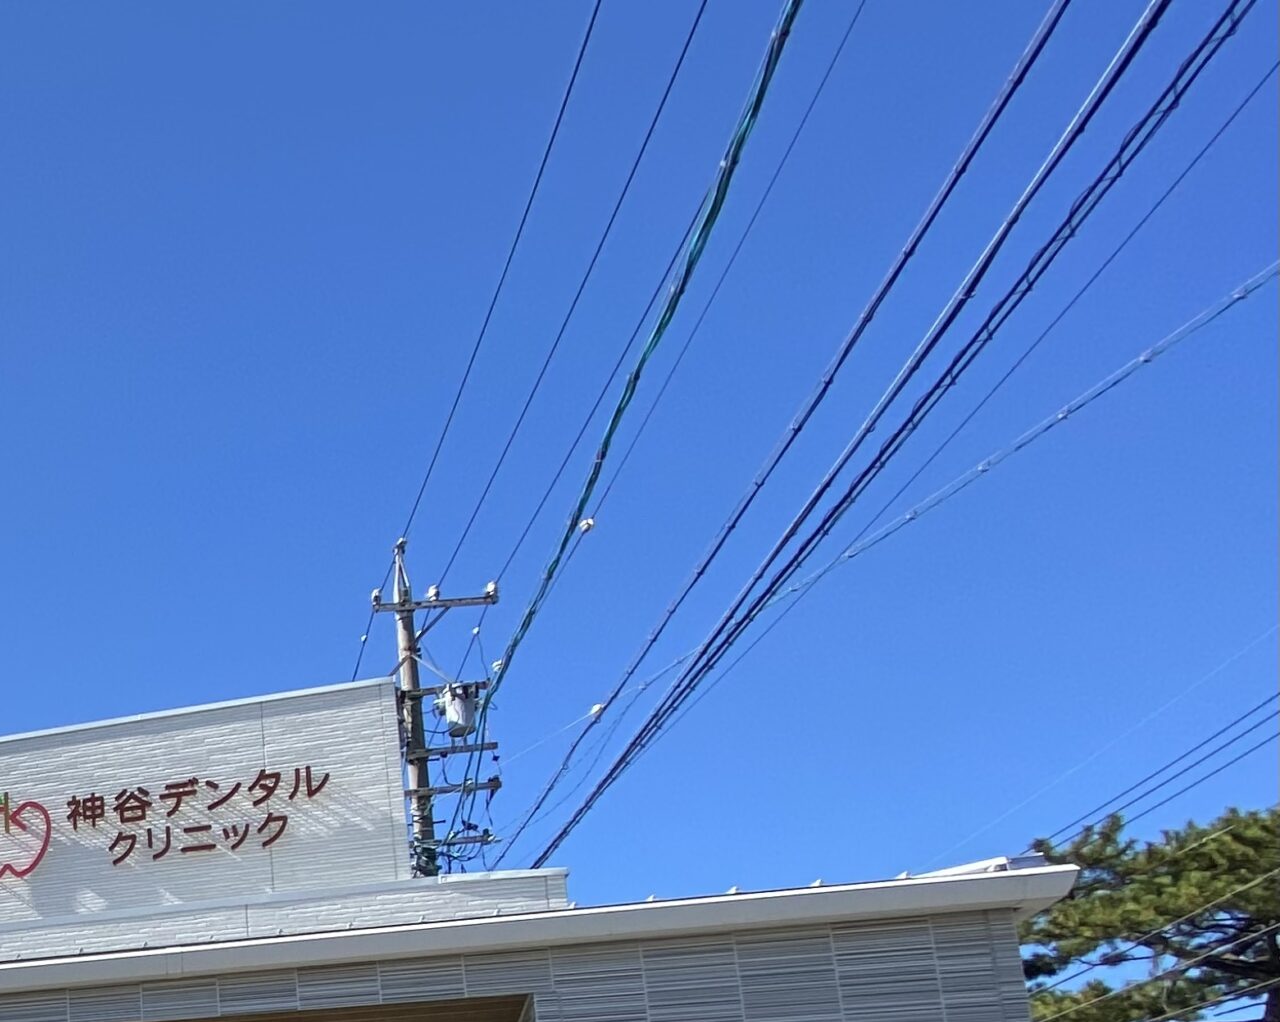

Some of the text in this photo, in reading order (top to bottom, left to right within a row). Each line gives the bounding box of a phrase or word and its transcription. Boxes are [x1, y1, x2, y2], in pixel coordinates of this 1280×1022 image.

[66, 766, 330, 831] 神谷デンタル
[108, 814, 289, 866] クリニック
